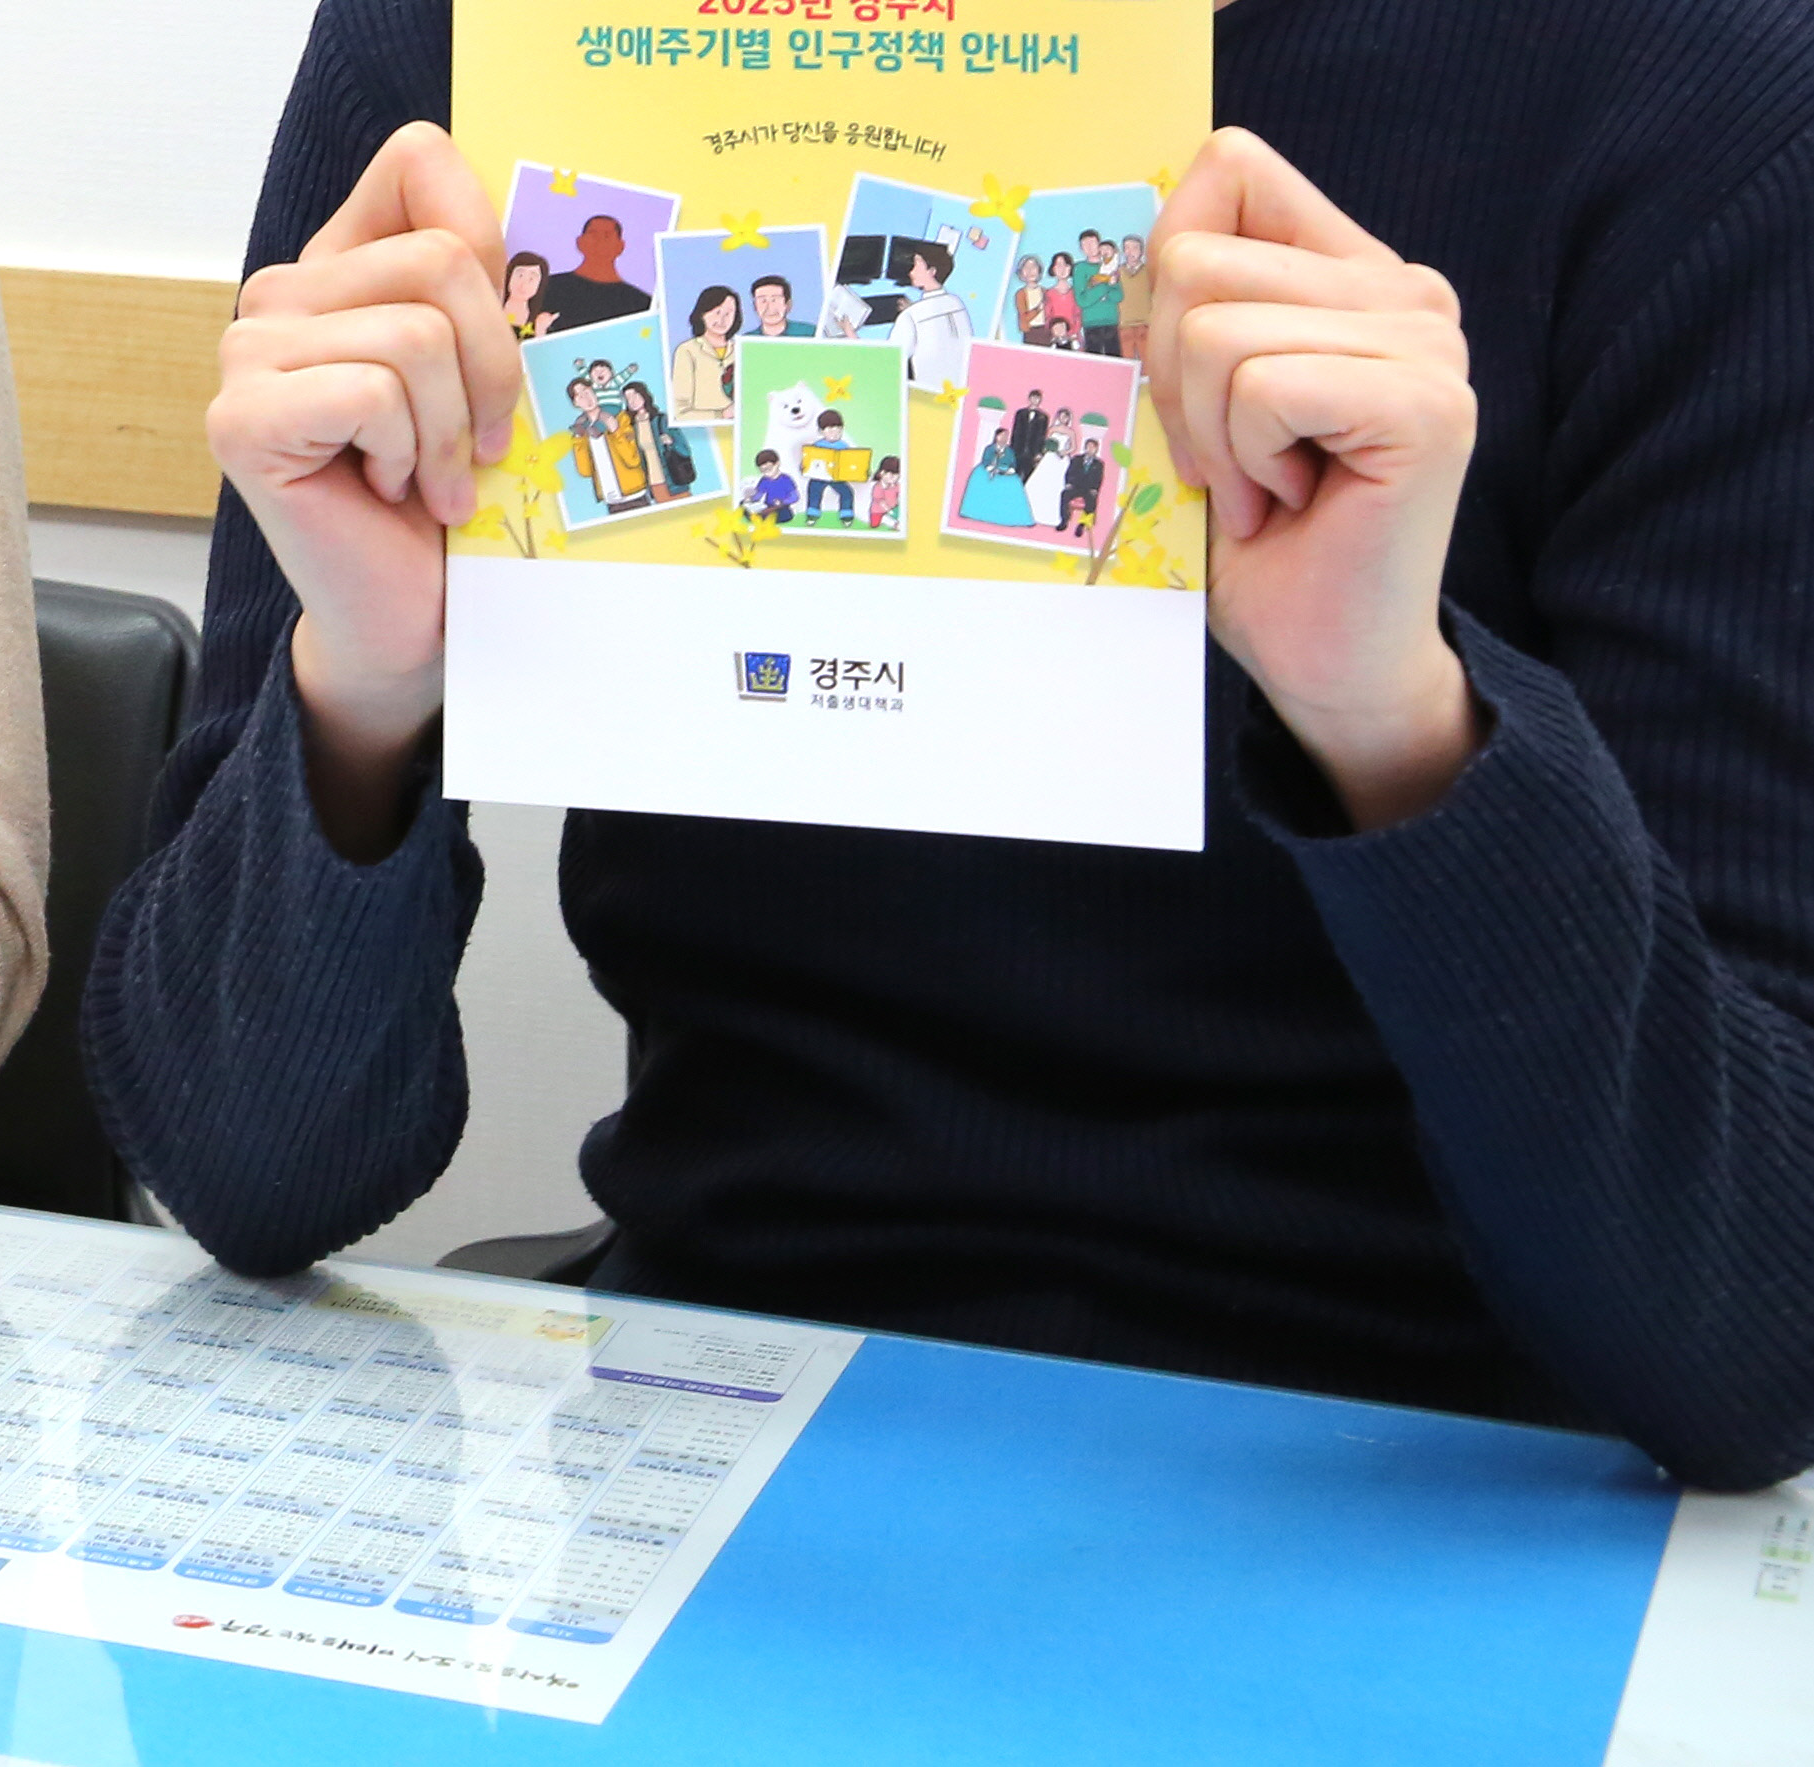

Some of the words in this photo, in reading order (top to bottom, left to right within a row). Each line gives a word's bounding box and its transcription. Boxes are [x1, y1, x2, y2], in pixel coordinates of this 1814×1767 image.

[576, 25, 771, 70] 생애주기별
[788, 29, 946, 72] 인구정책
[960, 31, 1080, 75] 안내서
[704, 124, 779, 155] 경주시가
[782, 120, 839, 143] 당신을
[845, 122, 948, 162] 응원합니다!
[810, 658, 904, 693] 경주시
[810, 693, 904, 712] 저출생대책과
